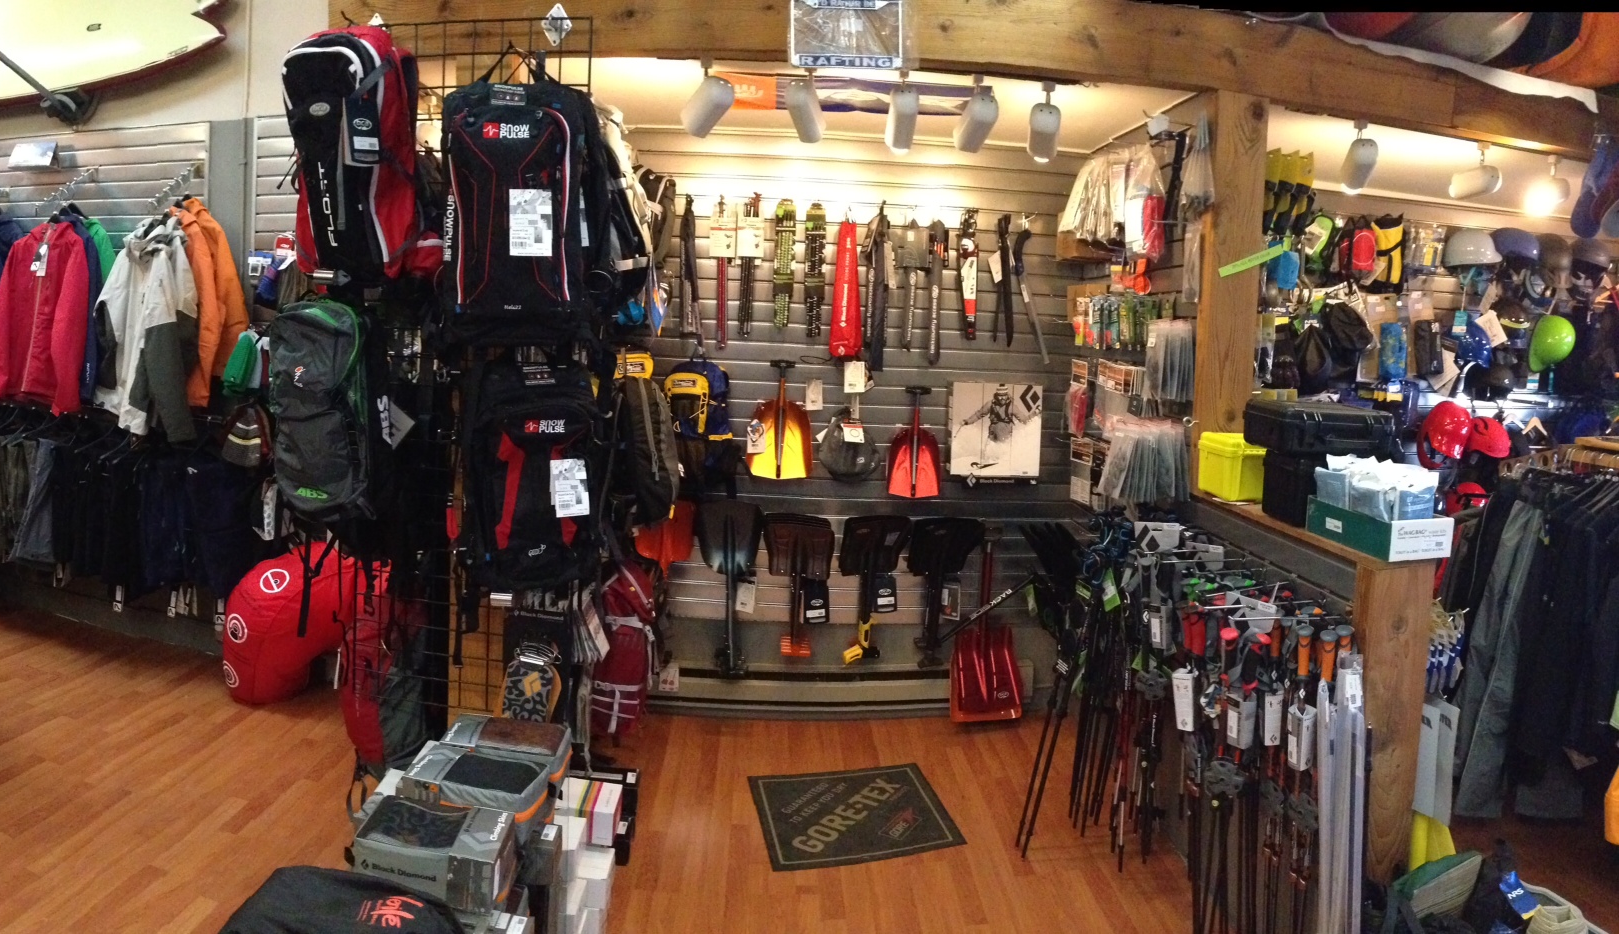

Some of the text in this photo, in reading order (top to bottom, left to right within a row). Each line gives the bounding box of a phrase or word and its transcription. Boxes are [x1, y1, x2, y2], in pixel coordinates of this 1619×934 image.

[800, 56, 891, 67] RAFTING
[443, 194, 455, 261] SNOWPULSE
[906, 307, 914, 341] backcountry
[930, 319, 938, 354] backcountry
[377, 395, 393, 445] ABS
[539, 425, 566, 433] PULSE
[540, 419, 566, 427] SNOW
[295, 487, 329, 499] ABS
[520, 611, 564, 621] Black Diamond
[782, 782, 829, 814] GUARANTEED
[789, 782, 849, 824] TO KEEP YOU DRY
[489, 812, 509, 841] Climbing Skins
[792, 778, 901, 853] GORE-TEX
[889, 820, 910, 838] GORE
[372, 863, 437, 882] Black Diamond
[1507, 887, 1524, 900] NRS
